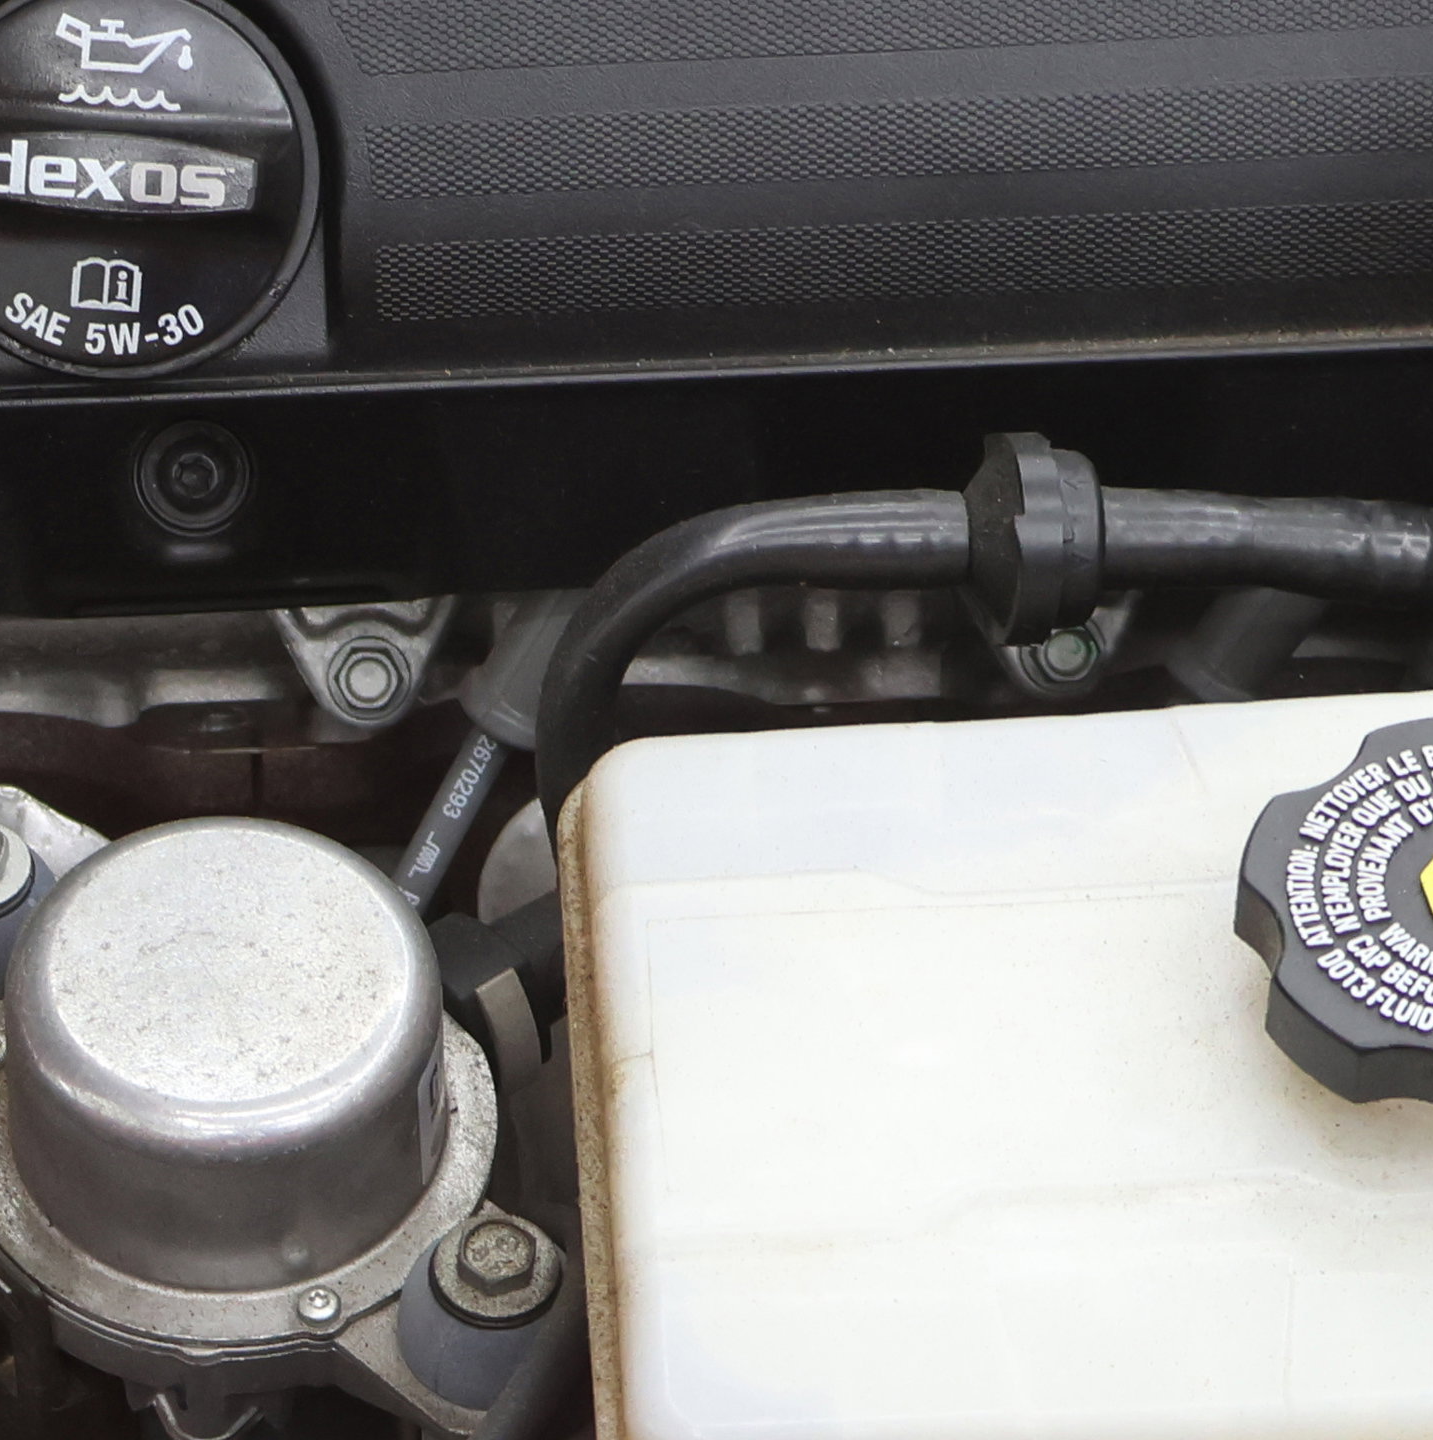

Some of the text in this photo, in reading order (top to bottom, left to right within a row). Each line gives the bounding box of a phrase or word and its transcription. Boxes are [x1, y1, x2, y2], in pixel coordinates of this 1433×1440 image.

[4, 292, 205, 355] SAE 5W-30
[1387, 750, 1423, 778] LE
[1298, 762, 1391, 842] NETTOYER
[1320, 820, 1368, 935] N'EMPLOYER
[1350, 788, 1401, 828] QUE
[1394, 773, 1432, 802] DU
[1355, 811, 1414, 922] PROVENANT
[1285, 844, 1334, 948] ATTENTION:
[1316, 947, 1377, 1000] DOT3
[1346, 933, 1392, 970] CAP
